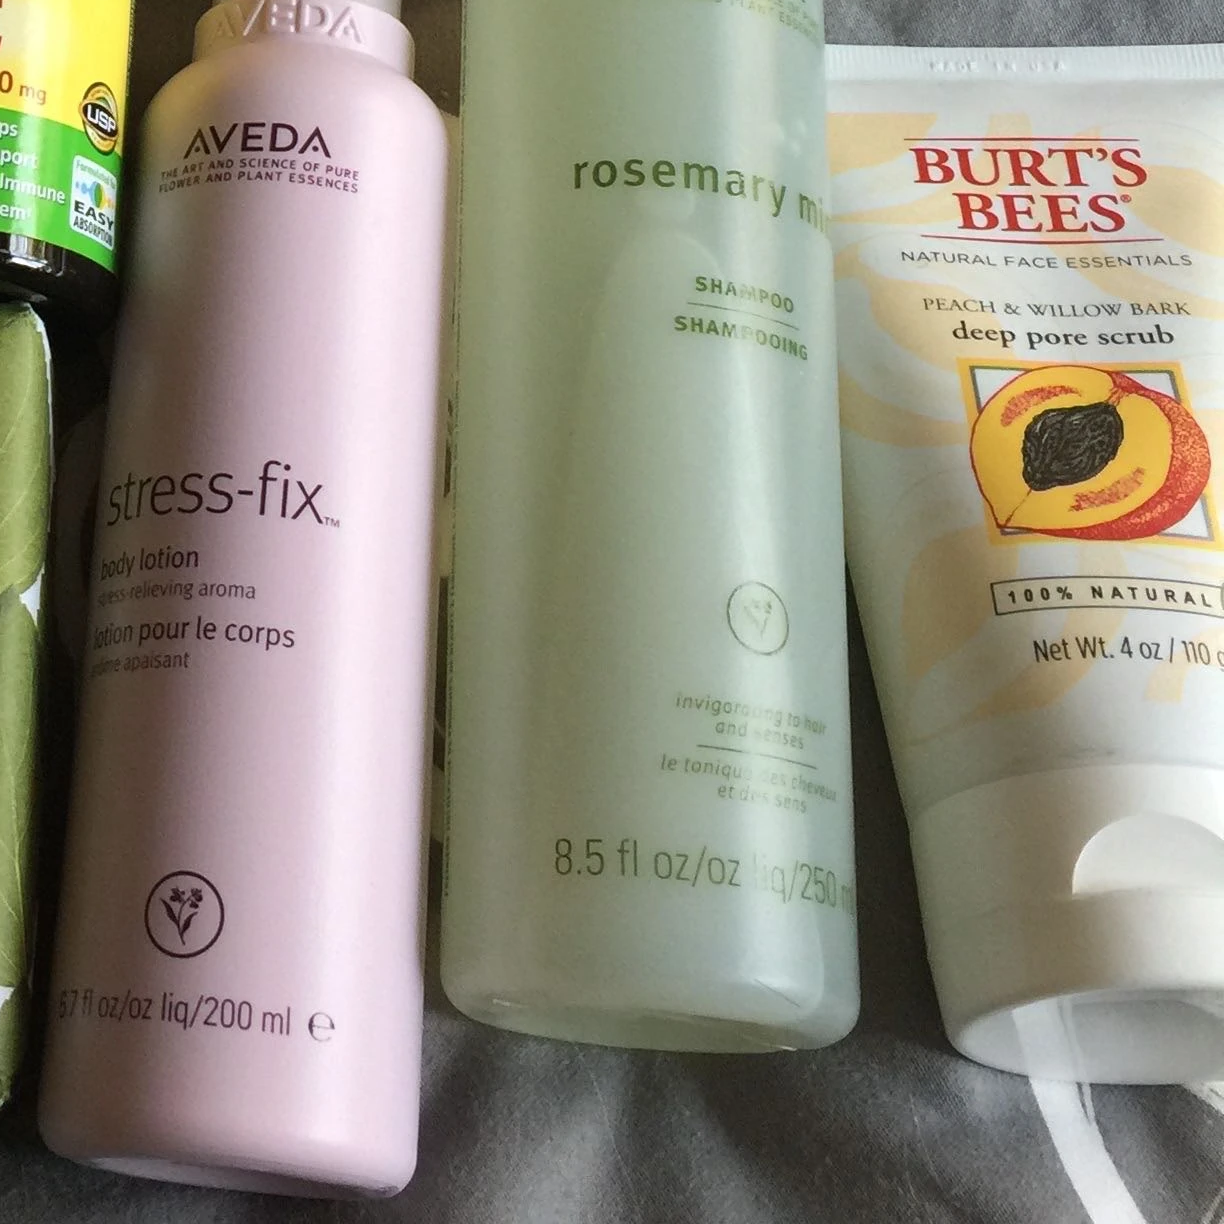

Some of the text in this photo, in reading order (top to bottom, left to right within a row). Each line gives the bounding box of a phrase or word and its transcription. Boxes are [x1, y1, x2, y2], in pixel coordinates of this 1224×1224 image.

[86, 103, 117, 134] USP
[183, 121, 333, 160] AVEDA
[237, 170, 359, 195] PLANT ESSENCES
[239, 158, 360, 182] SCIENCE PURE
[908, 146, 1149, 189] BURT'S
[572, 157, 787, 218] rosemary
[73, 199, 115, 232] EASY
[900, 250, 1194, 270] NATURAL FACE ESSENTIALS
[694, 275, 796, 314] SHAMPOO
[922, 297, 1192, 319] PEACH & WILLOW BARK
[673, 315, 809, 361] SHAMPOOING
[952, 320, 1176, 351] deep pore scrub
[106, 459, 325, 527] stress-fix
[99, 545, 200, 582] body lotion
[198, 581, 257, 600] aroma
[1007, 585, 1213, 608] 100% NATURAL
[138, 615, 296, 652] pour le corps
[1033, 635, 1212, 667] Net Wt. 4 oz 110
[554, 837, 743, 888] 8.5 fl oz/oz
[160, 990, 292, 1037] liq/200 ml
